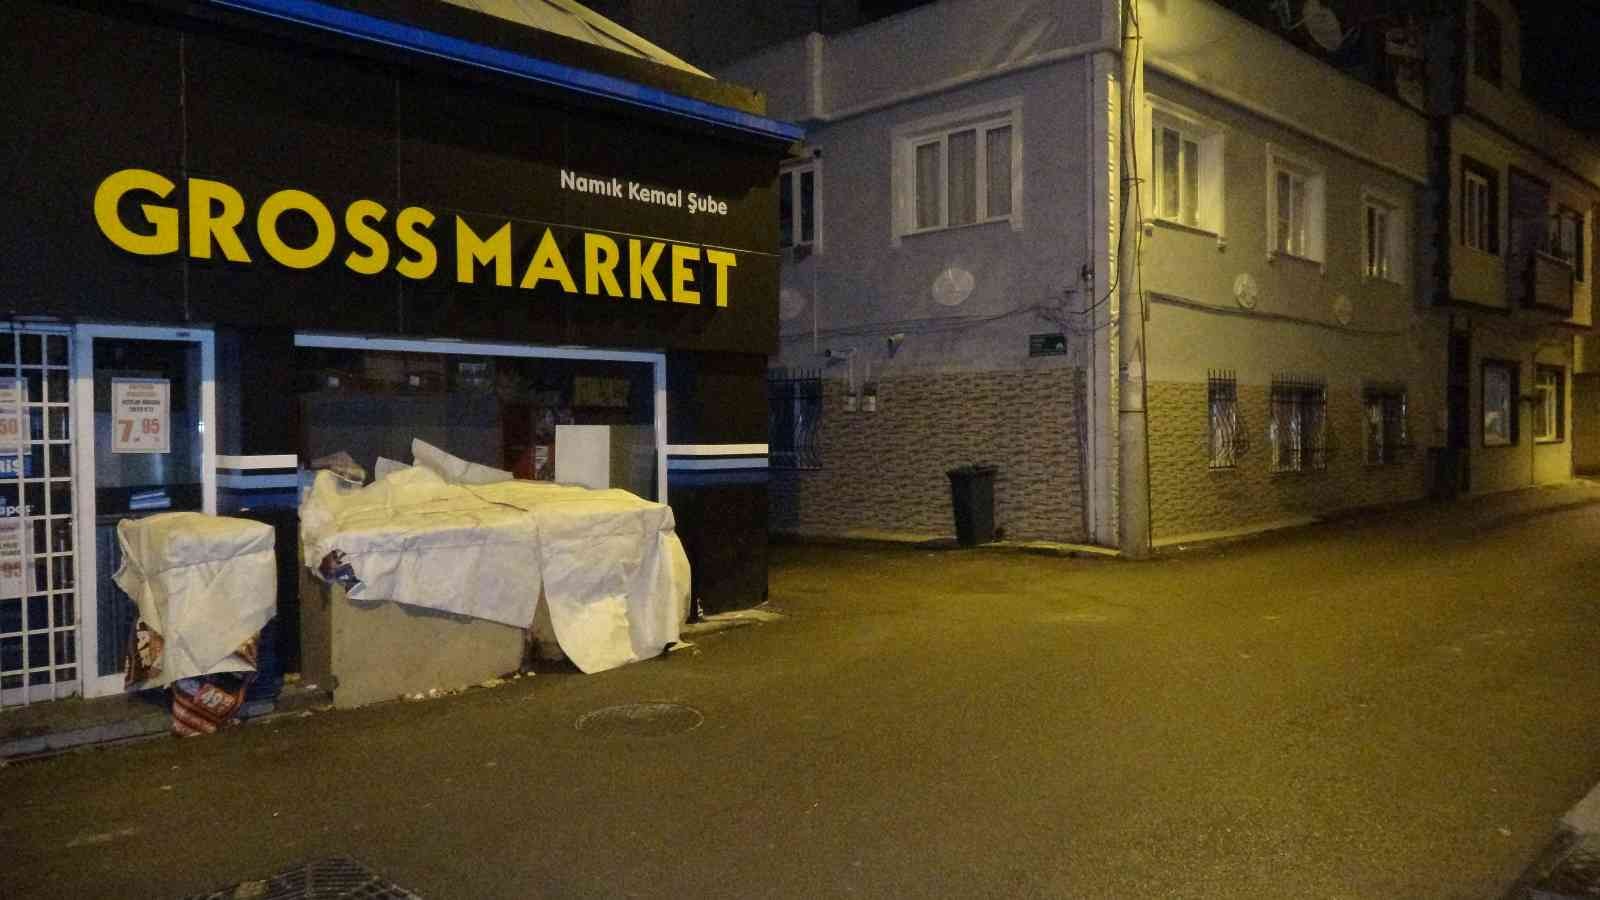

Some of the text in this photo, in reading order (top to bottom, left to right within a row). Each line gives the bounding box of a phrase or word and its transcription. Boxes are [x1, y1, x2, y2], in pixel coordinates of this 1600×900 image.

[94, 168, 737, 307] GROSS MARKET
[560, 169, 728, 216] Namık Kemal Şube
